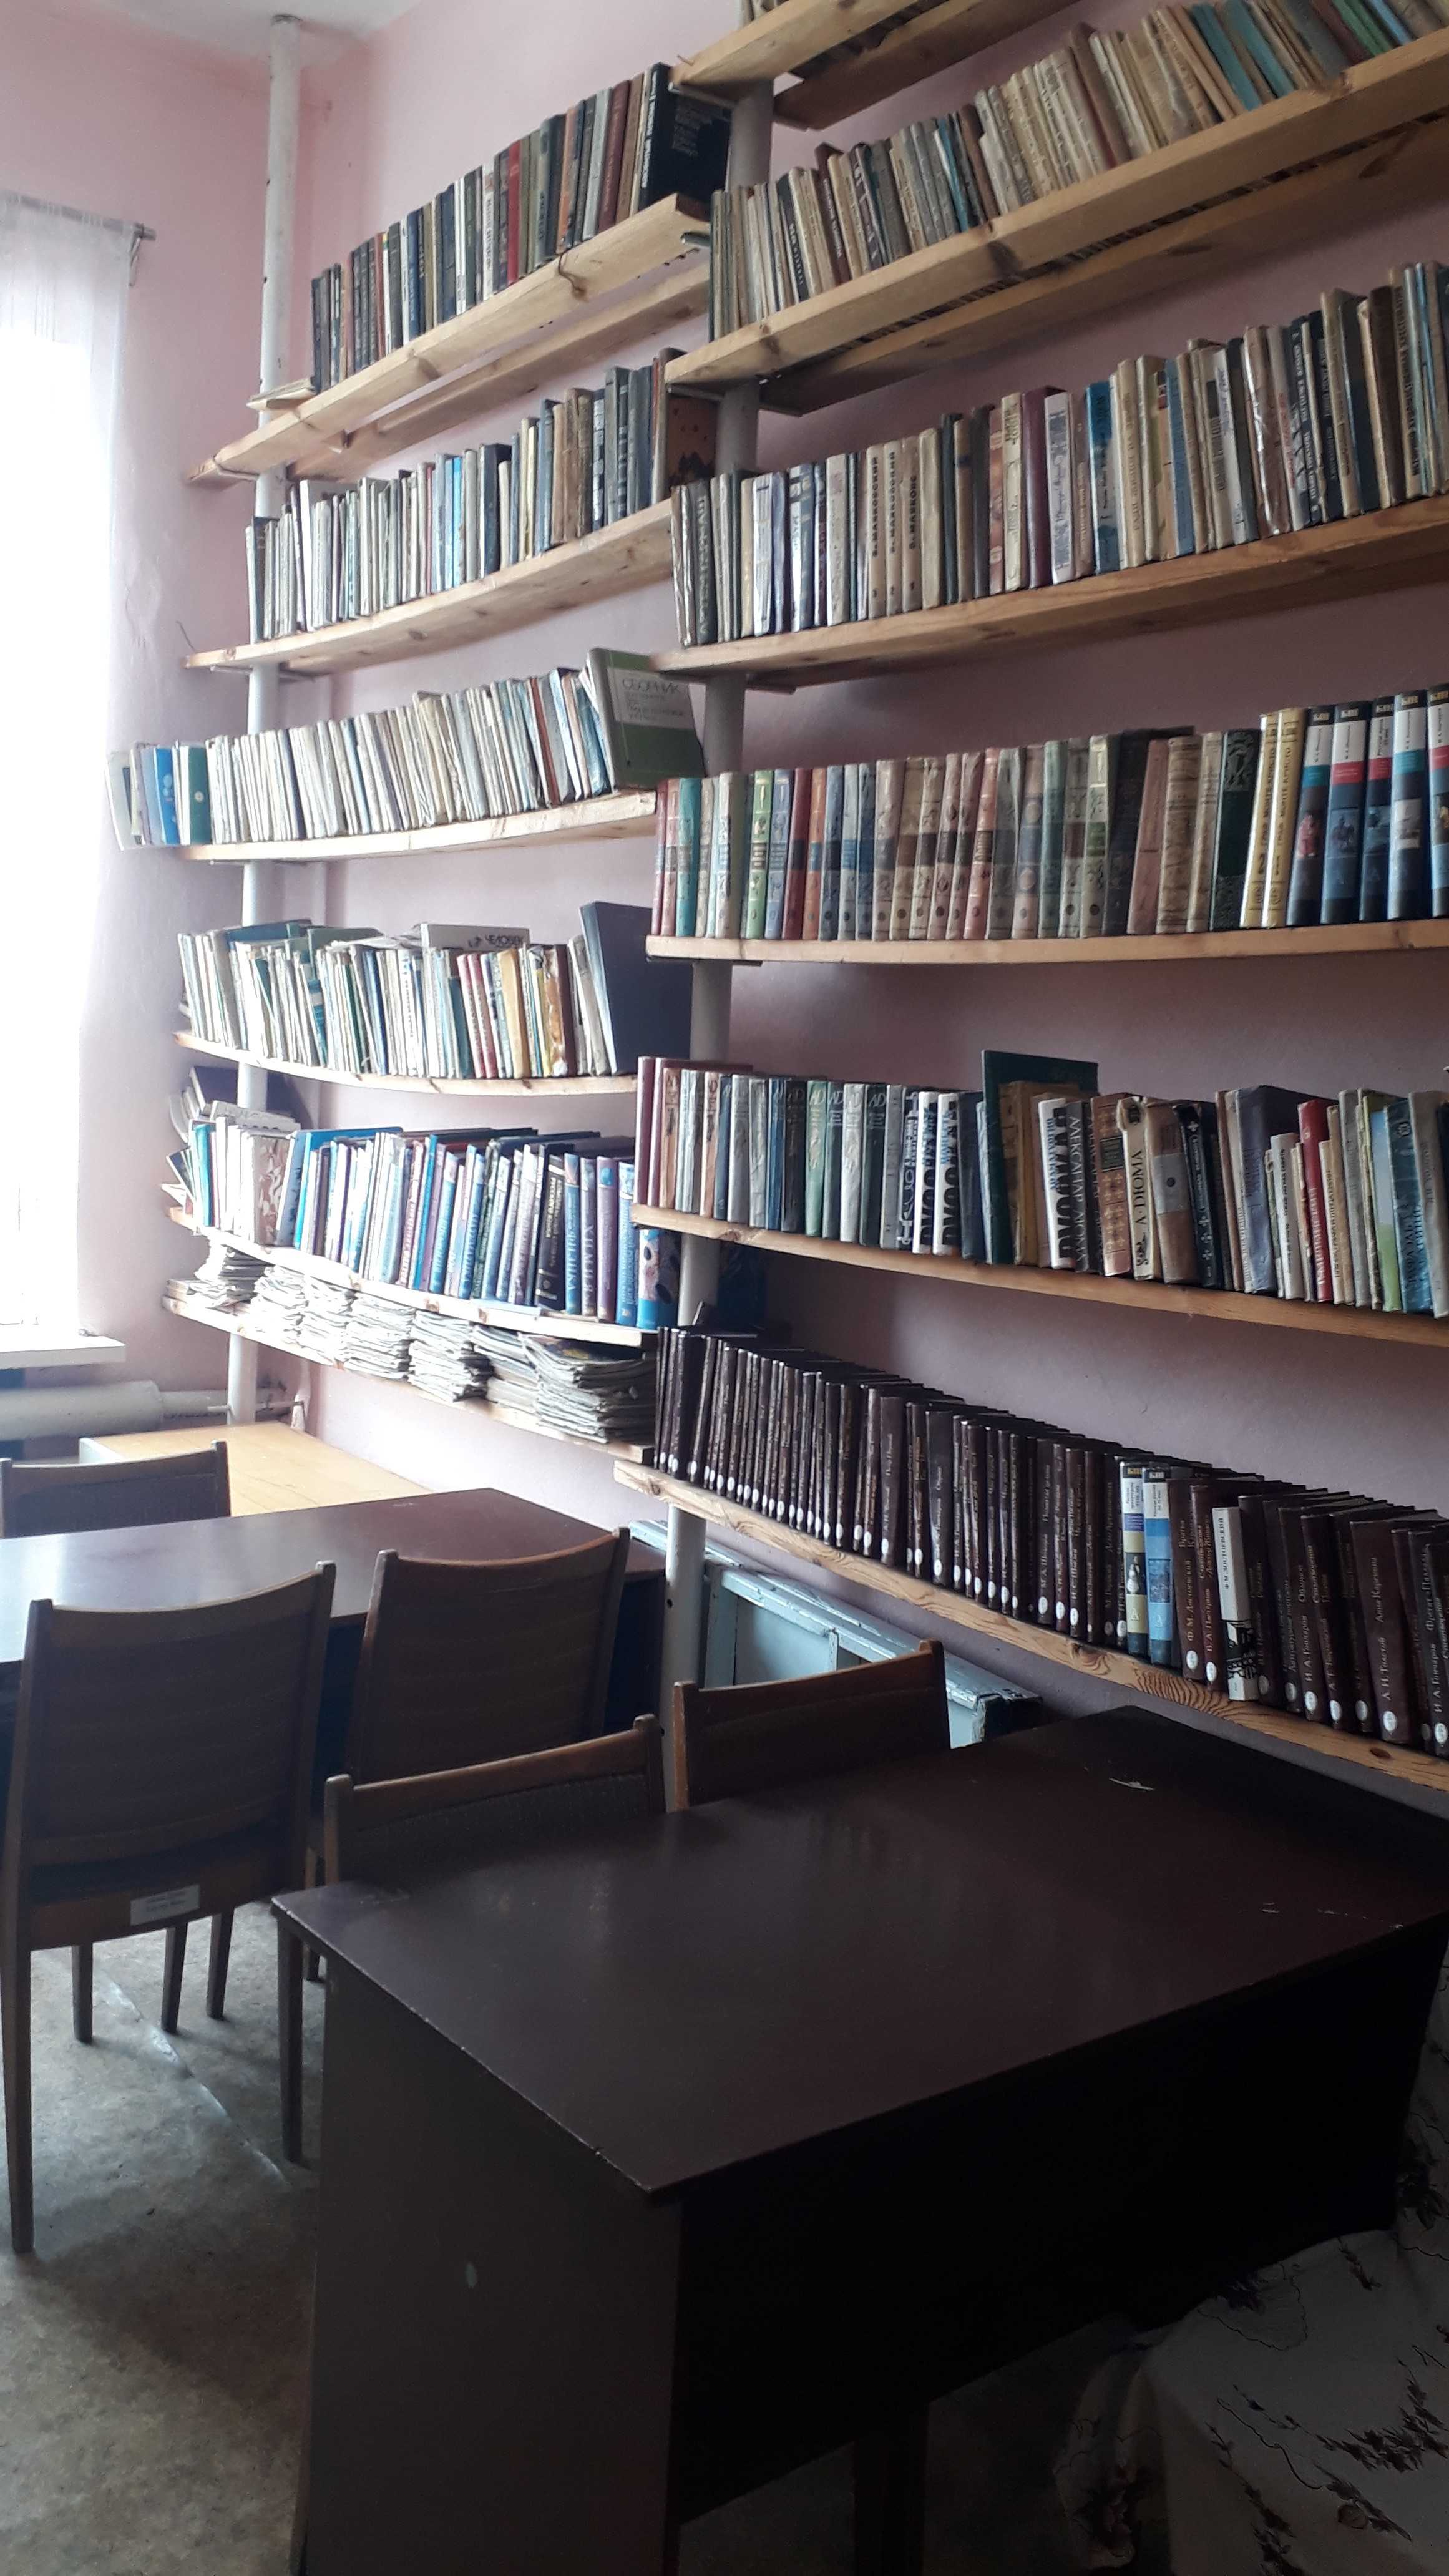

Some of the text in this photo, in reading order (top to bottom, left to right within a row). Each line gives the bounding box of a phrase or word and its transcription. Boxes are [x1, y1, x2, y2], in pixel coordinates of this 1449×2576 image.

[889, 451, 897, 537] МАЯКОВСКИЙ
[1068, 1116, 1083, 1203] АЛЕКСАНДР
[583, 1224, 595, 1293] ХИМИЯ
[1178, 1520, 1186, 1548] Братья
[1185, 1560, 1194, 1613] Достоевский
[1373, 1600, 1384, 1623] Анна
[1301, 1615, 1310, 1655] Гончаров
[1377, 1636, 1389, 1672] Толстой
[1430, 1642, 1440, 1685] Гончаров
